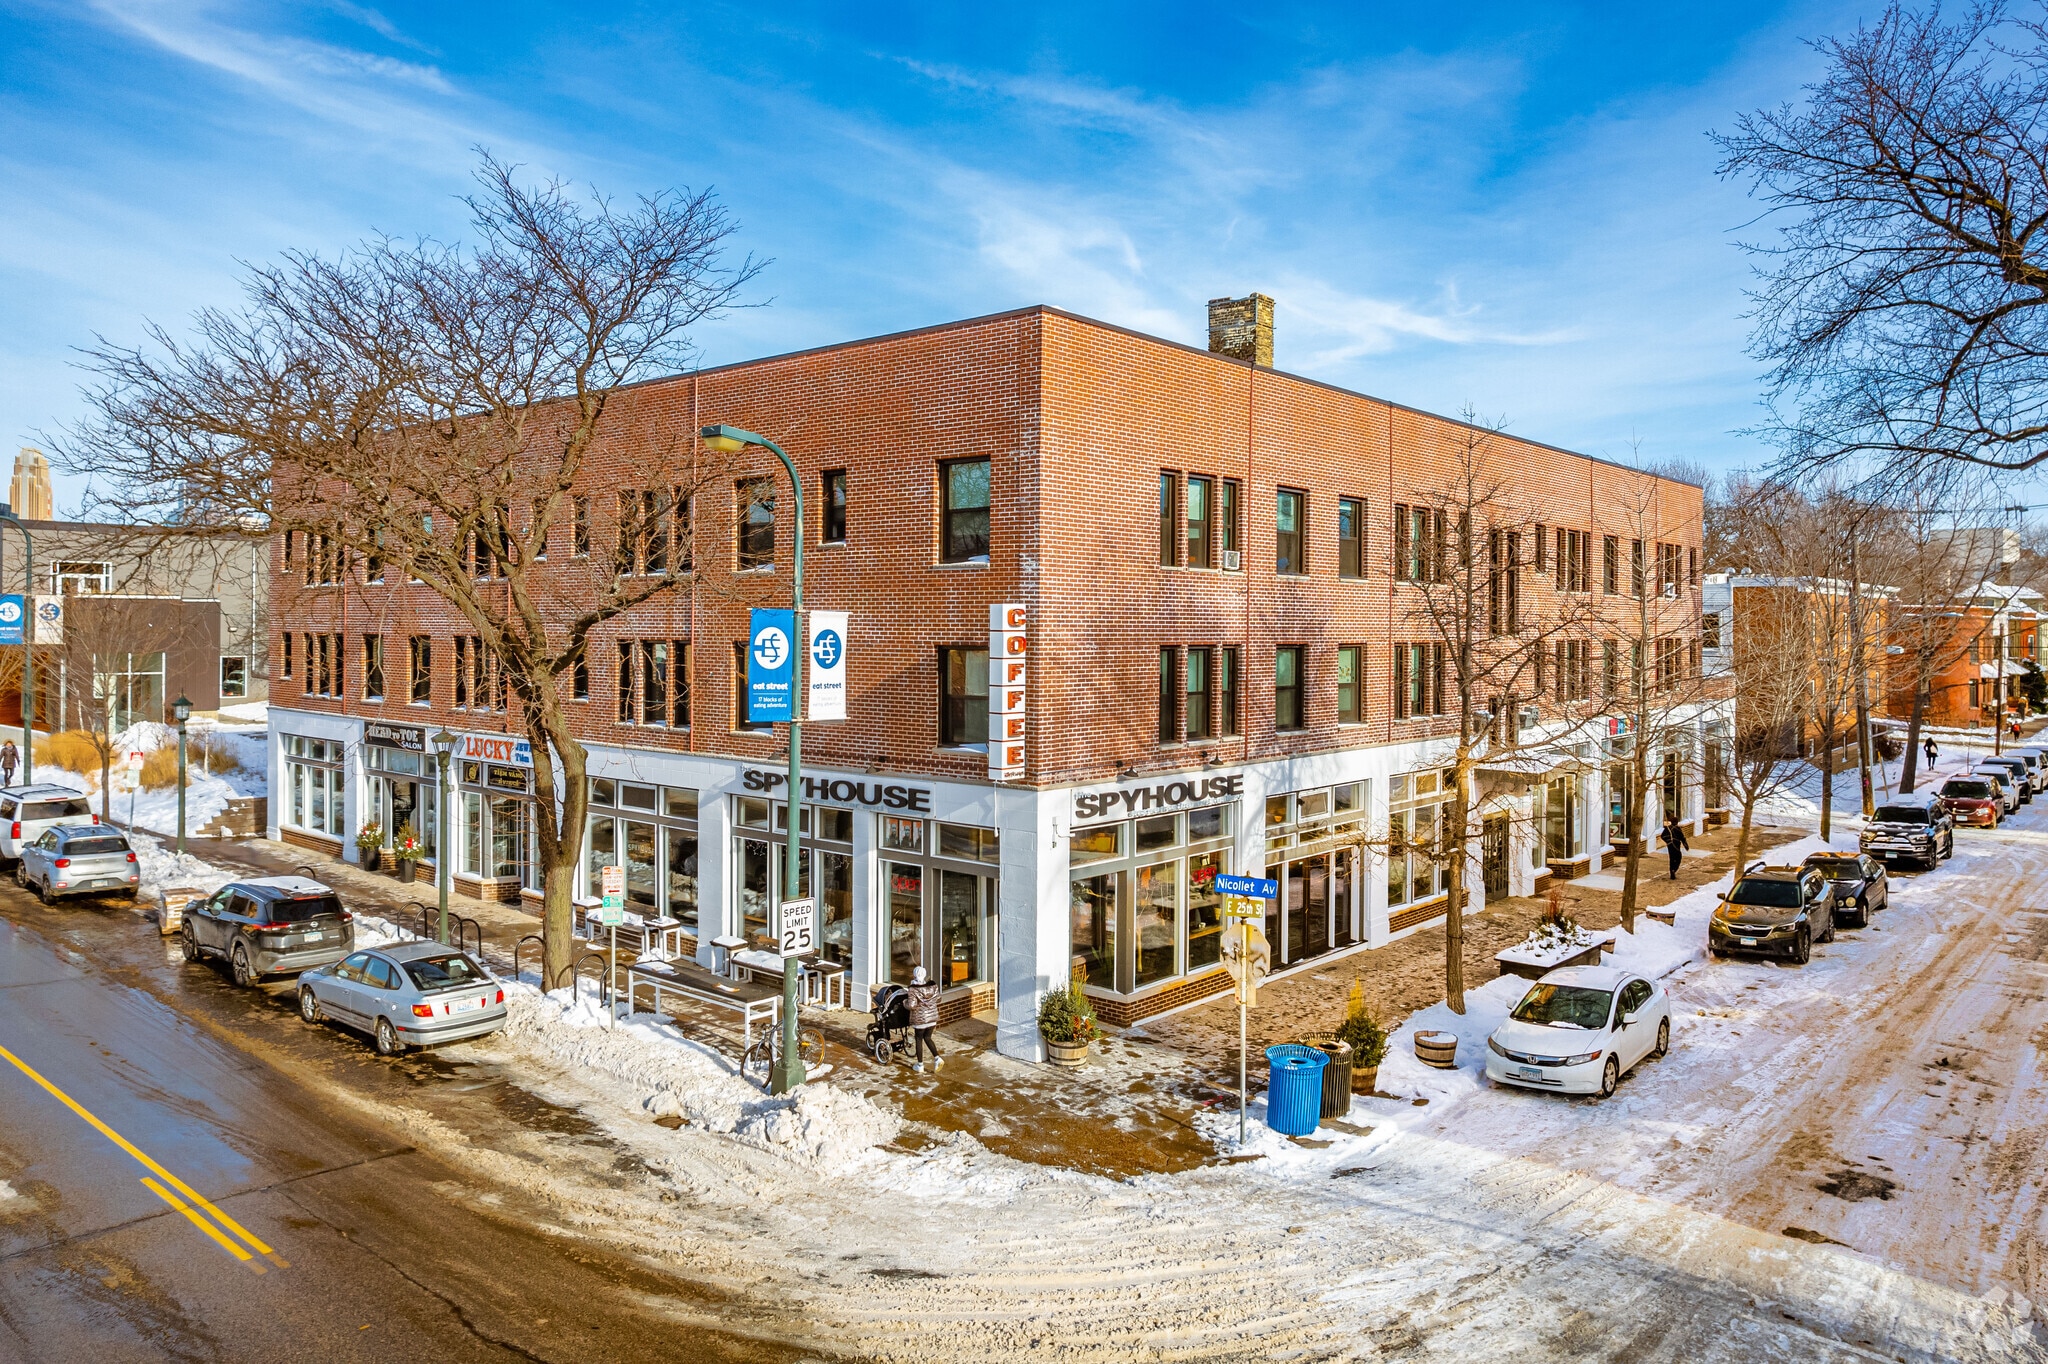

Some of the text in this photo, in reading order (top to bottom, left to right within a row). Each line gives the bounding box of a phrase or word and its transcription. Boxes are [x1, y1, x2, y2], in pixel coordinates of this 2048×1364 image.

[753, 682, 788, 690] eat street
[823, 682, 842, 690] street
[1006, 608, 1026, 766] COFFEE
[368, 725, 391, 738] HEAD
[400, 729, 419, 742] TOE
[402, 741, 422, 749] SALON
[466, 737, 514, 761] LUCKY
[1075, 774, 1244, 819] SPYHOUSE
[1217, 878, 1275, 894] Nicollet Av
[783, 905, 812, 917] SPEED
[1227, 901, 1263, 915] E 25th St
[786, 916, 808, 928] LIMIT
[784, 927, 811, 951] 25
